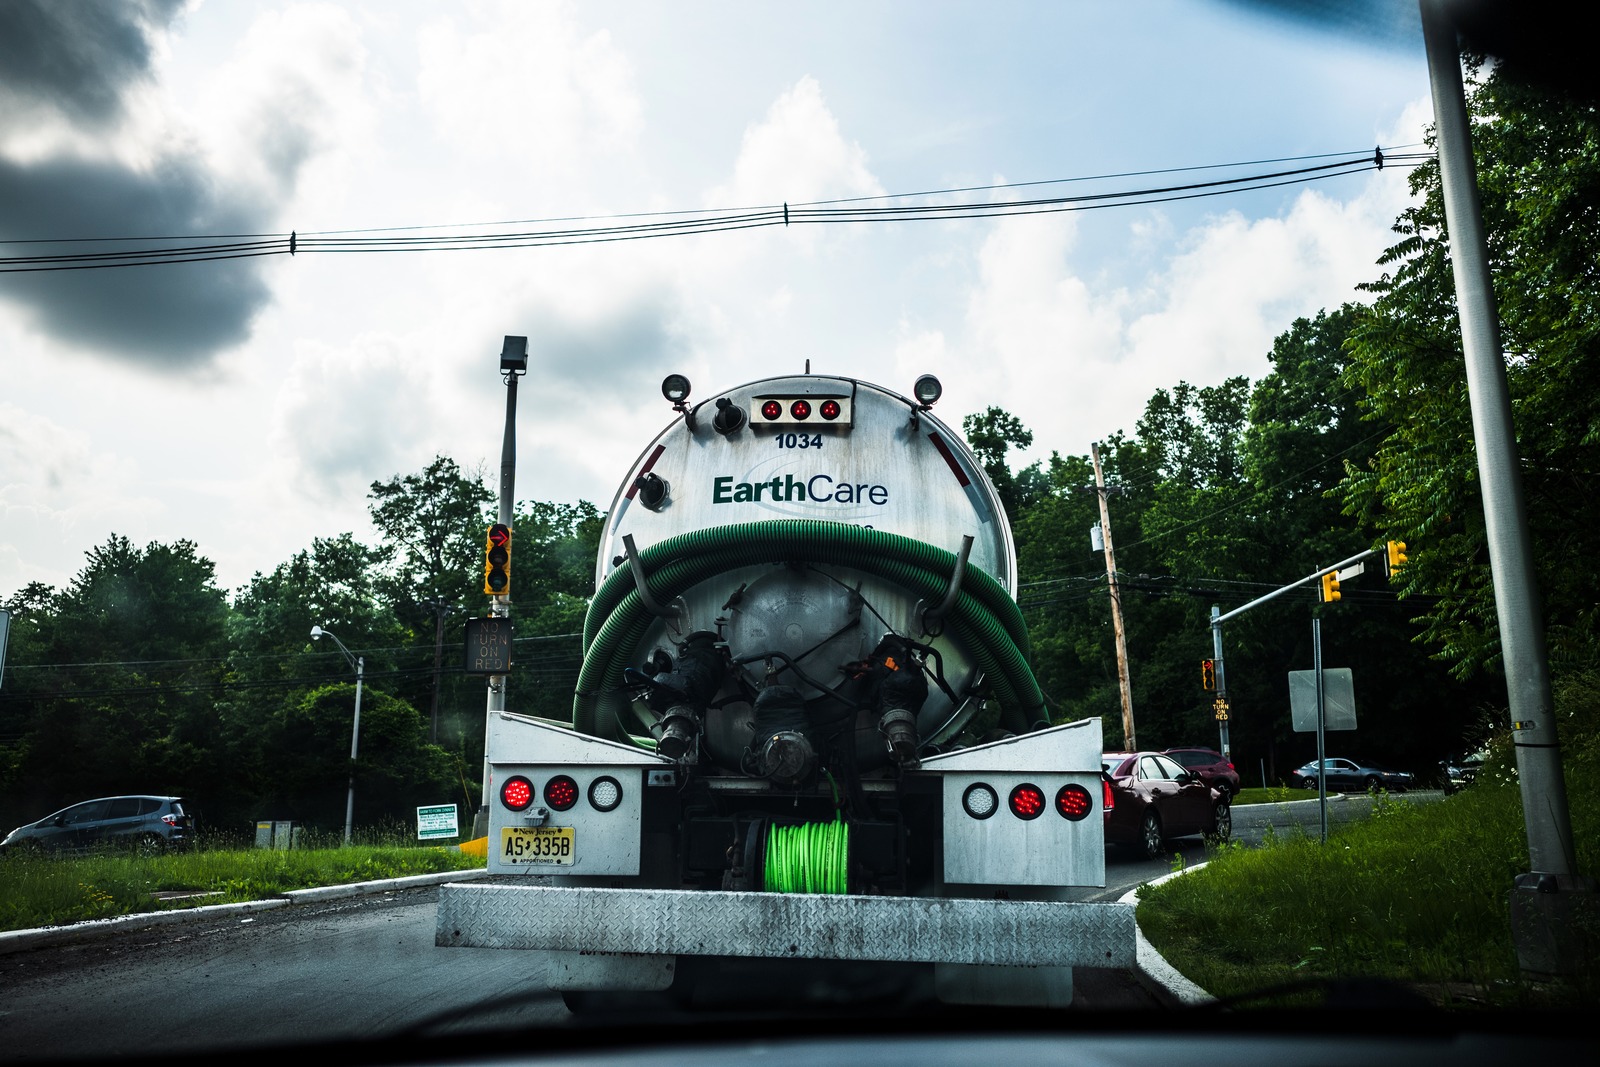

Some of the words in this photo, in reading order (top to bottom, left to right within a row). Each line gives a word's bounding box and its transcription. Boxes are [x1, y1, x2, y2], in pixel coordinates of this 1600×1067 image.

[775, 433, 823, 449] 1034
[712, 474, 889, 506] EarthCare
[481, 622, 499, 633] NO
[473, 634, 507, 645] TURN
[480, 646, 498, 657] ON
[475, 659, 502, 669] RED
[536, 828, 556, 836] Jersey
